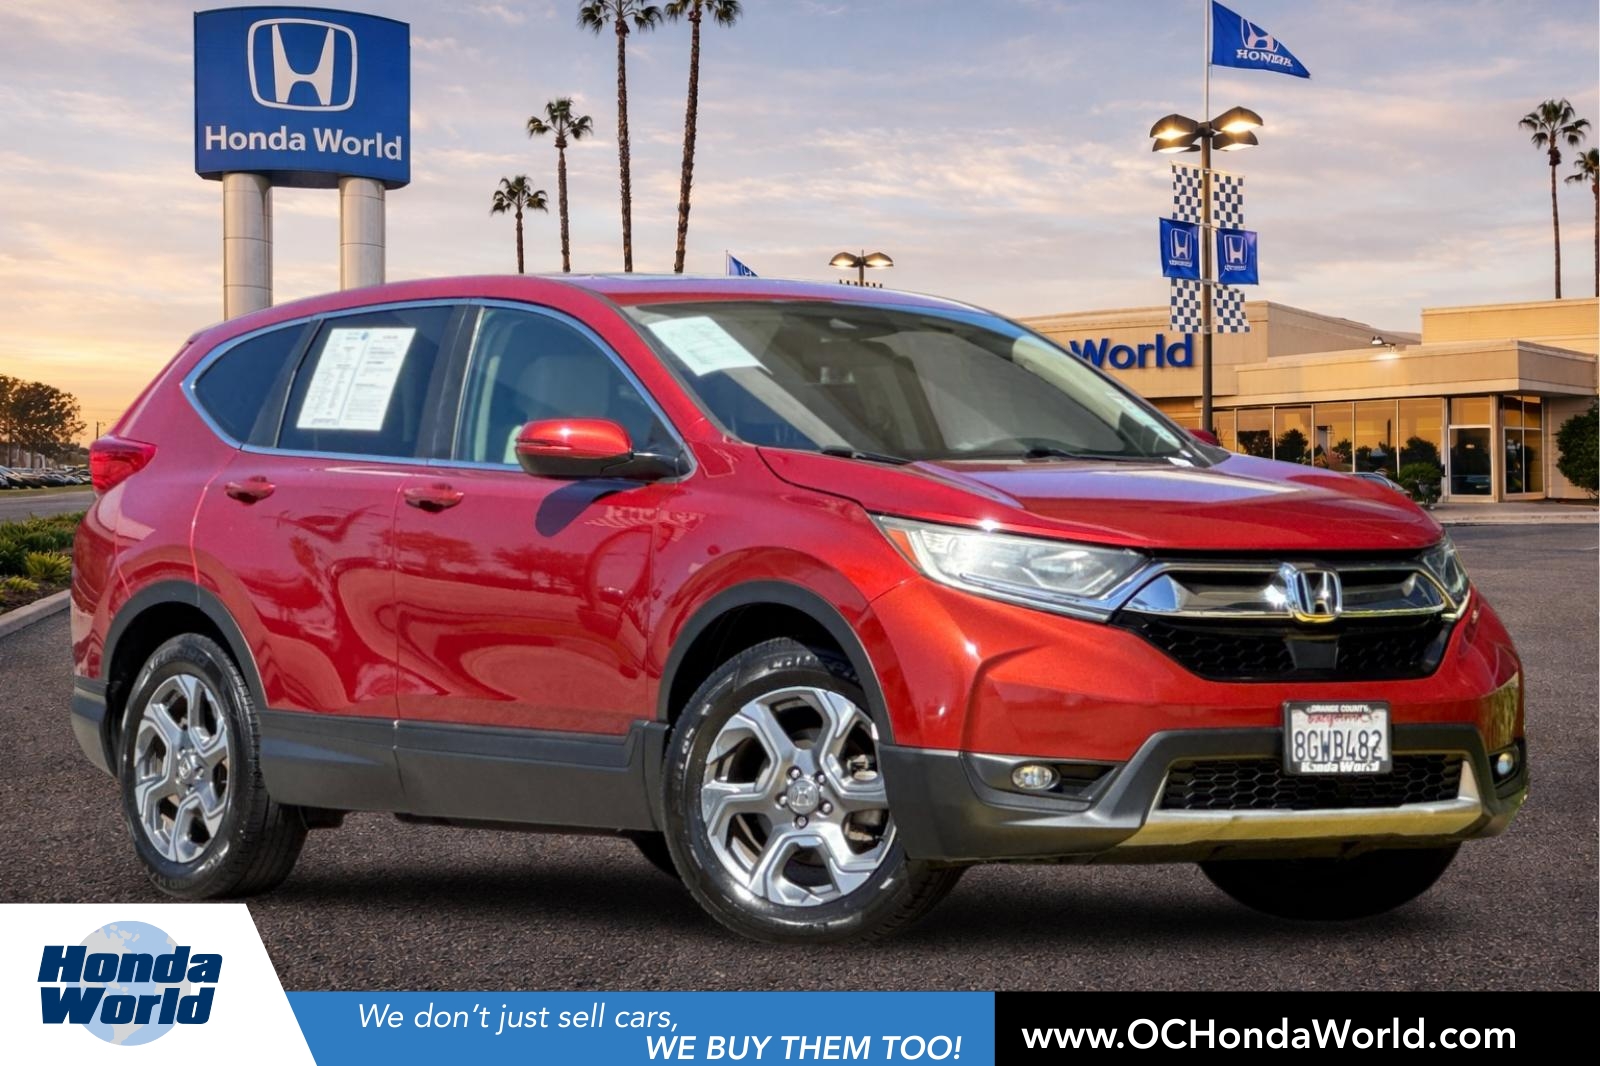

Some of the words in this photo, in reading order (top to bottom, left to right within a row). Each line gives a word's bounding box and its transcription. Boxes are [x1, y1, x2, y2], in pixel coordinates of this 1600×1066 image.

[205, 125, 306, 151] Honda
[313, 127, 402, 161] World
[1069, 333, 1193, 369] World
[1340, 704, 1369, 713] COUNTY
[1294, 730, 1383, 761] 8GWB482
